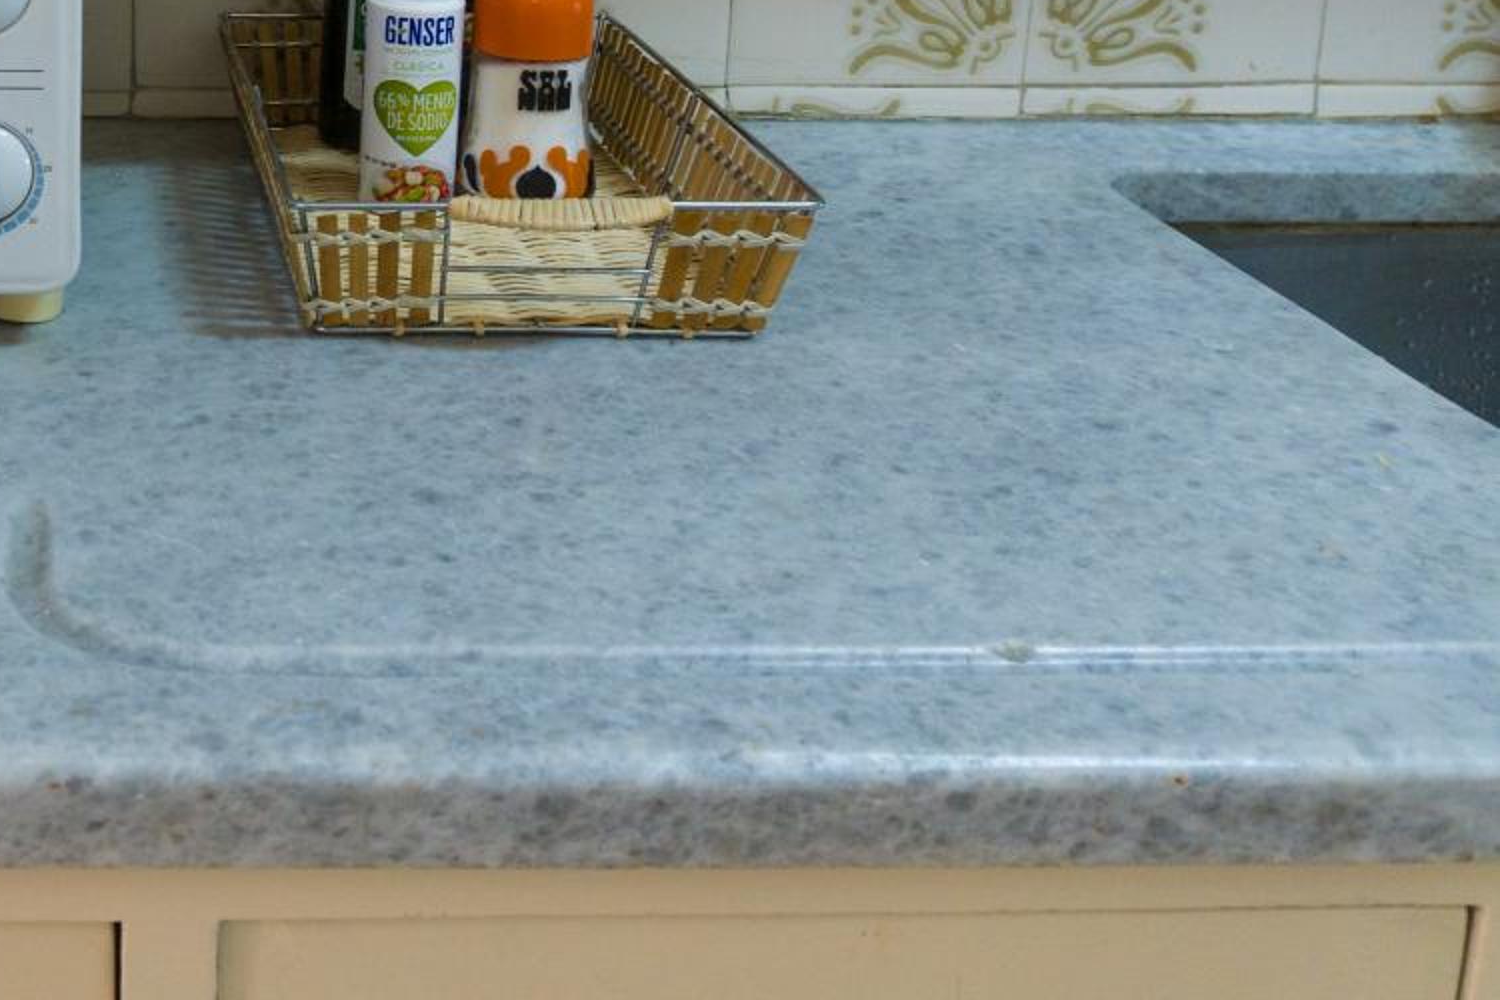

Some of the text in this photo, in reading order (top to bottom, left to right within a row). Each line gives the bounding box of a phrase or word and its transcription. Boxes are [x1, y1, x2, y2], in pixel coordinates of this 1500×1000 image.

[385, 15, 456, 47] GENSER
[386, 110, 449, 132] DE SODIO
